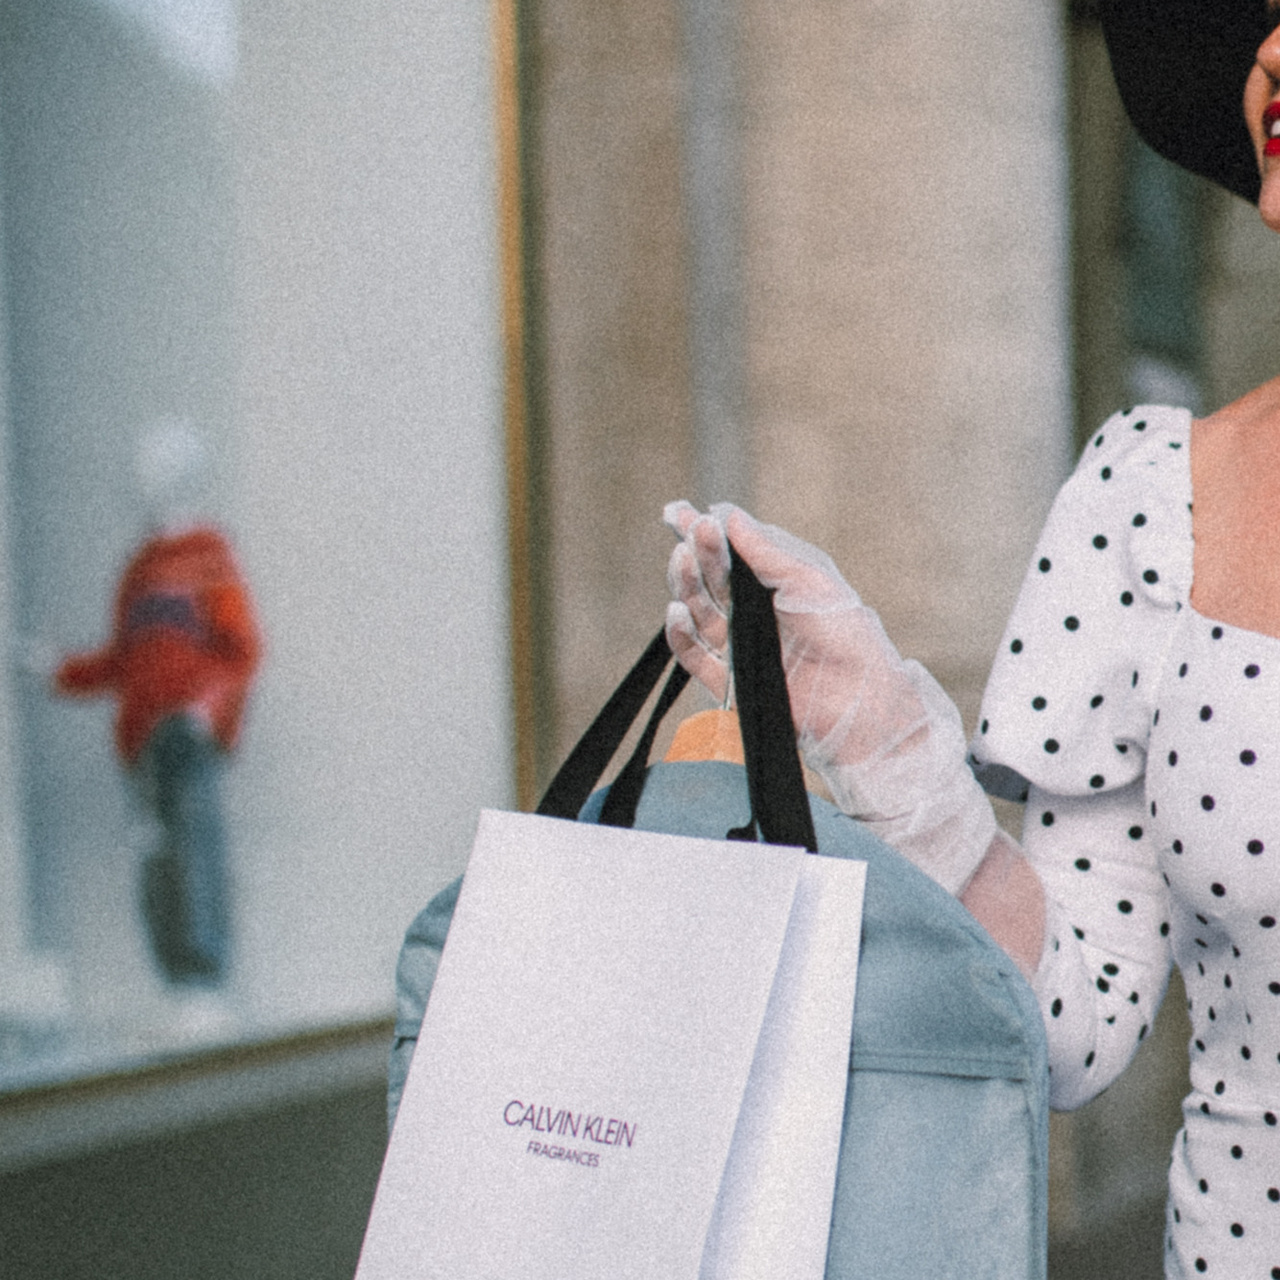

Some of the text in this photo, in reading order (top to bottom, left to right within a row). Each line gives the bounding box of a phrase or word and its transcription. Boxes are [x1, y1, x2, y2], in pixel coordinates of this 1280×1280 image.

[503, 1099, 637, 1148] CALVIN KLEIN
[526, 1140, 600, 1168] FRAGRANCES
